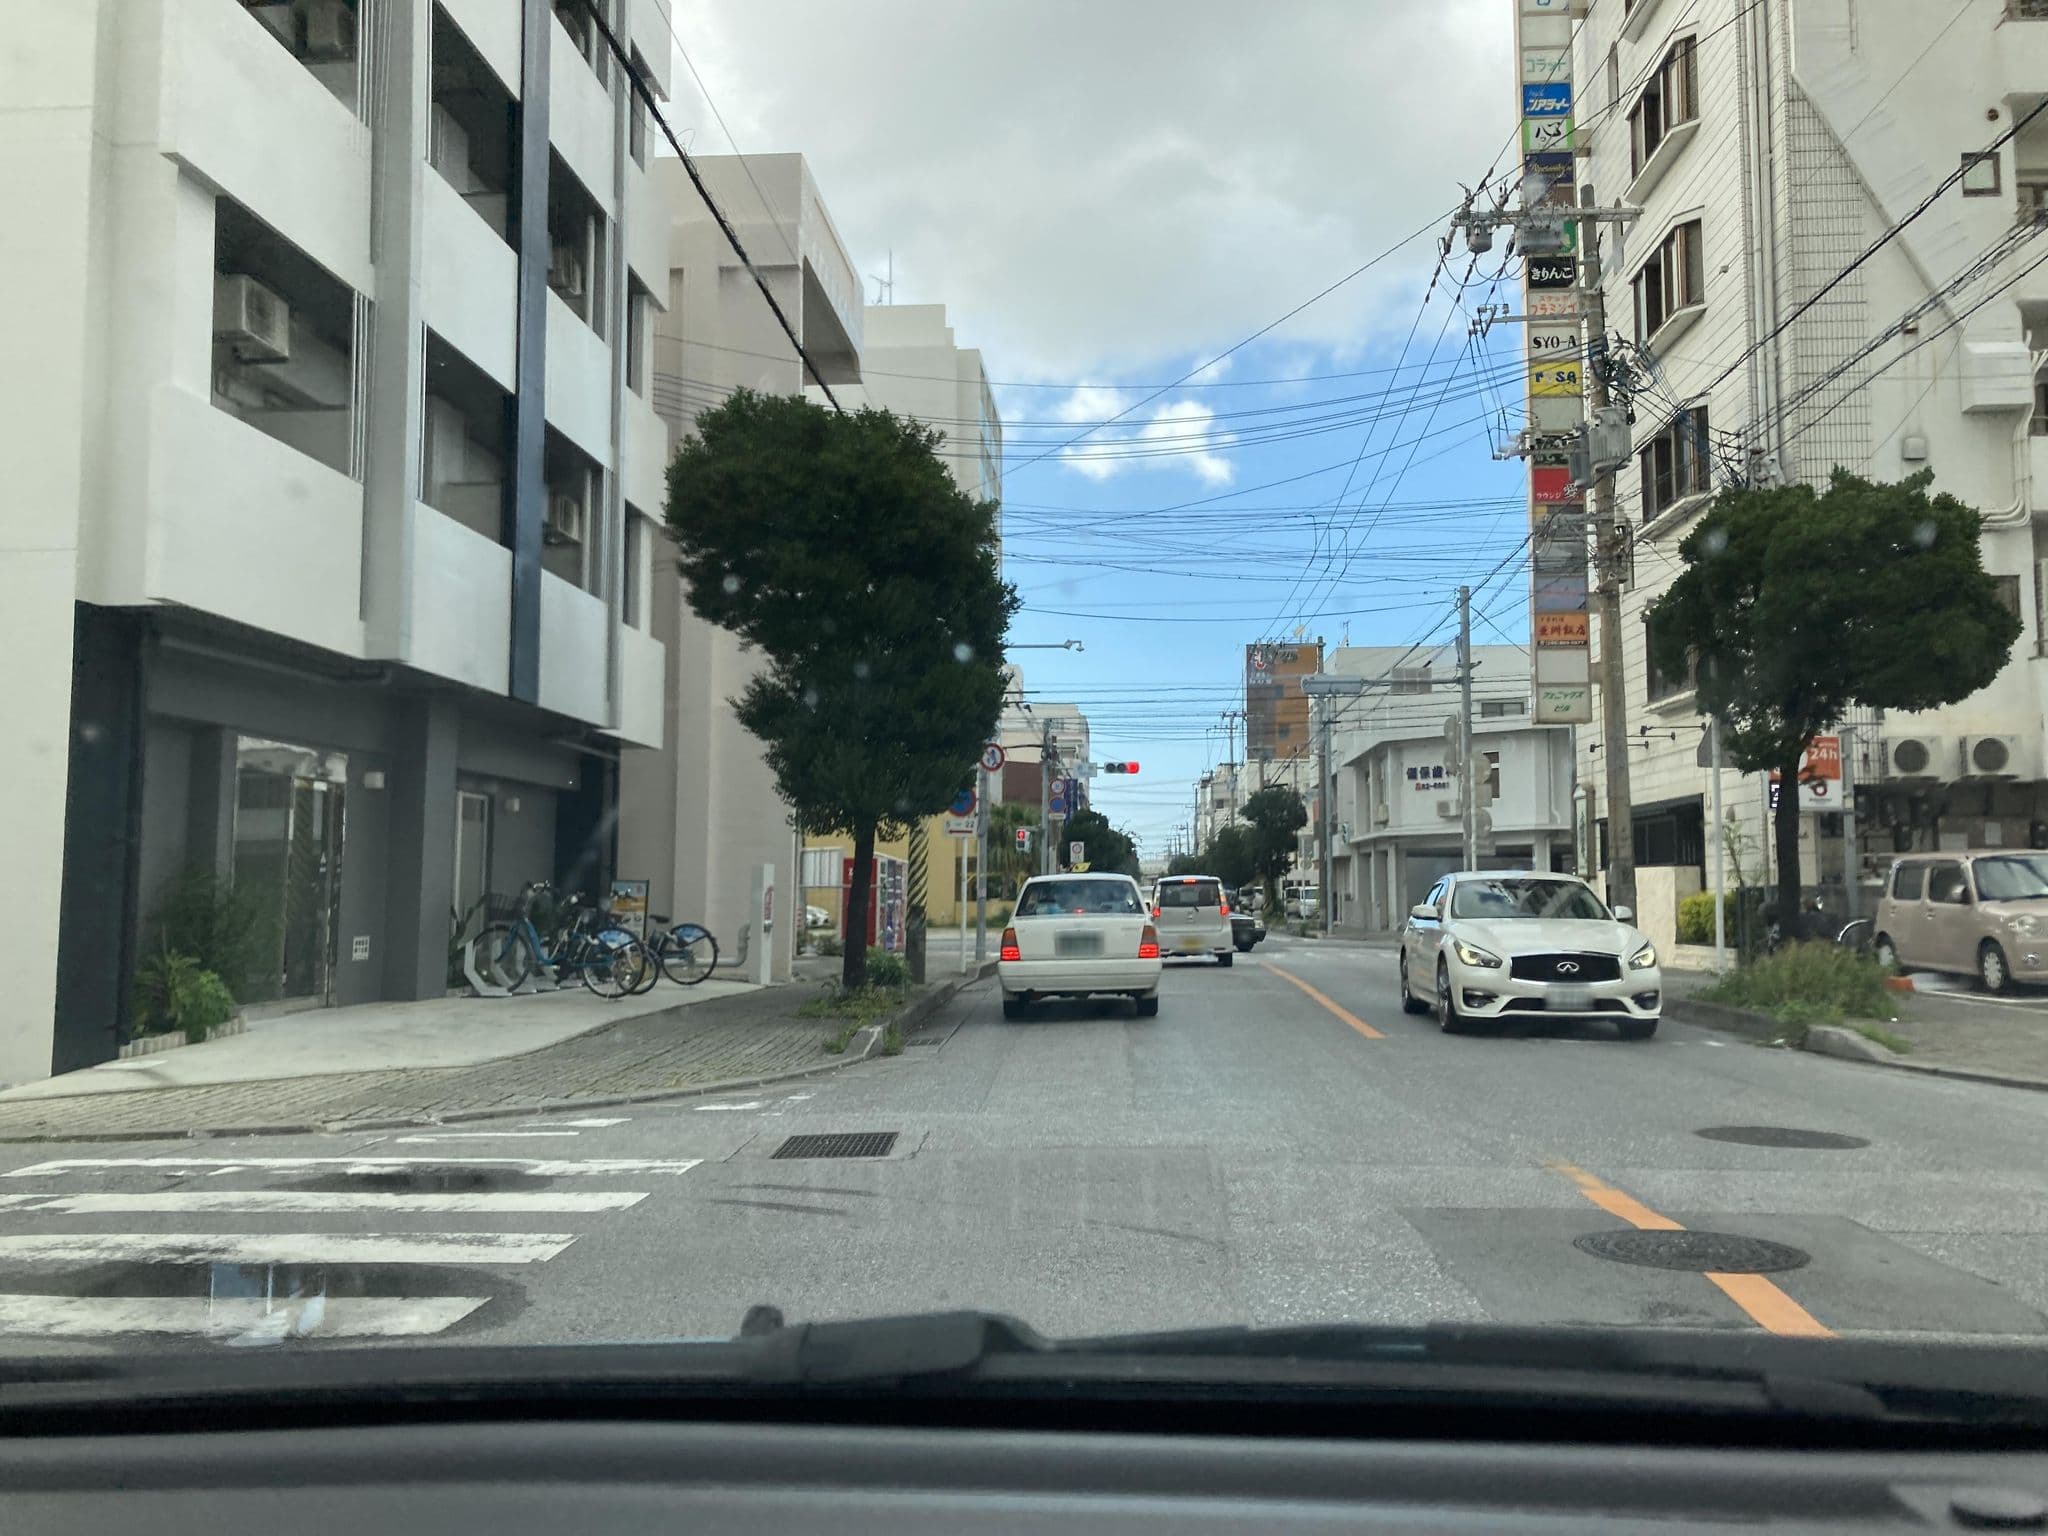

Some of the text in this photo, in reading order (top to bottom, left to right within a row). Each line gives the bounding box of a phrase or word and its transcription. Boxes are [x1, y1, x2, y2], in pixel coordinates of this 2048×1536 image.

[1531, 267, 1573, 281] きりんこ
[1533, 335, 1577, 349] SYO-A
[1809, 748, 1838, 760] 24h
